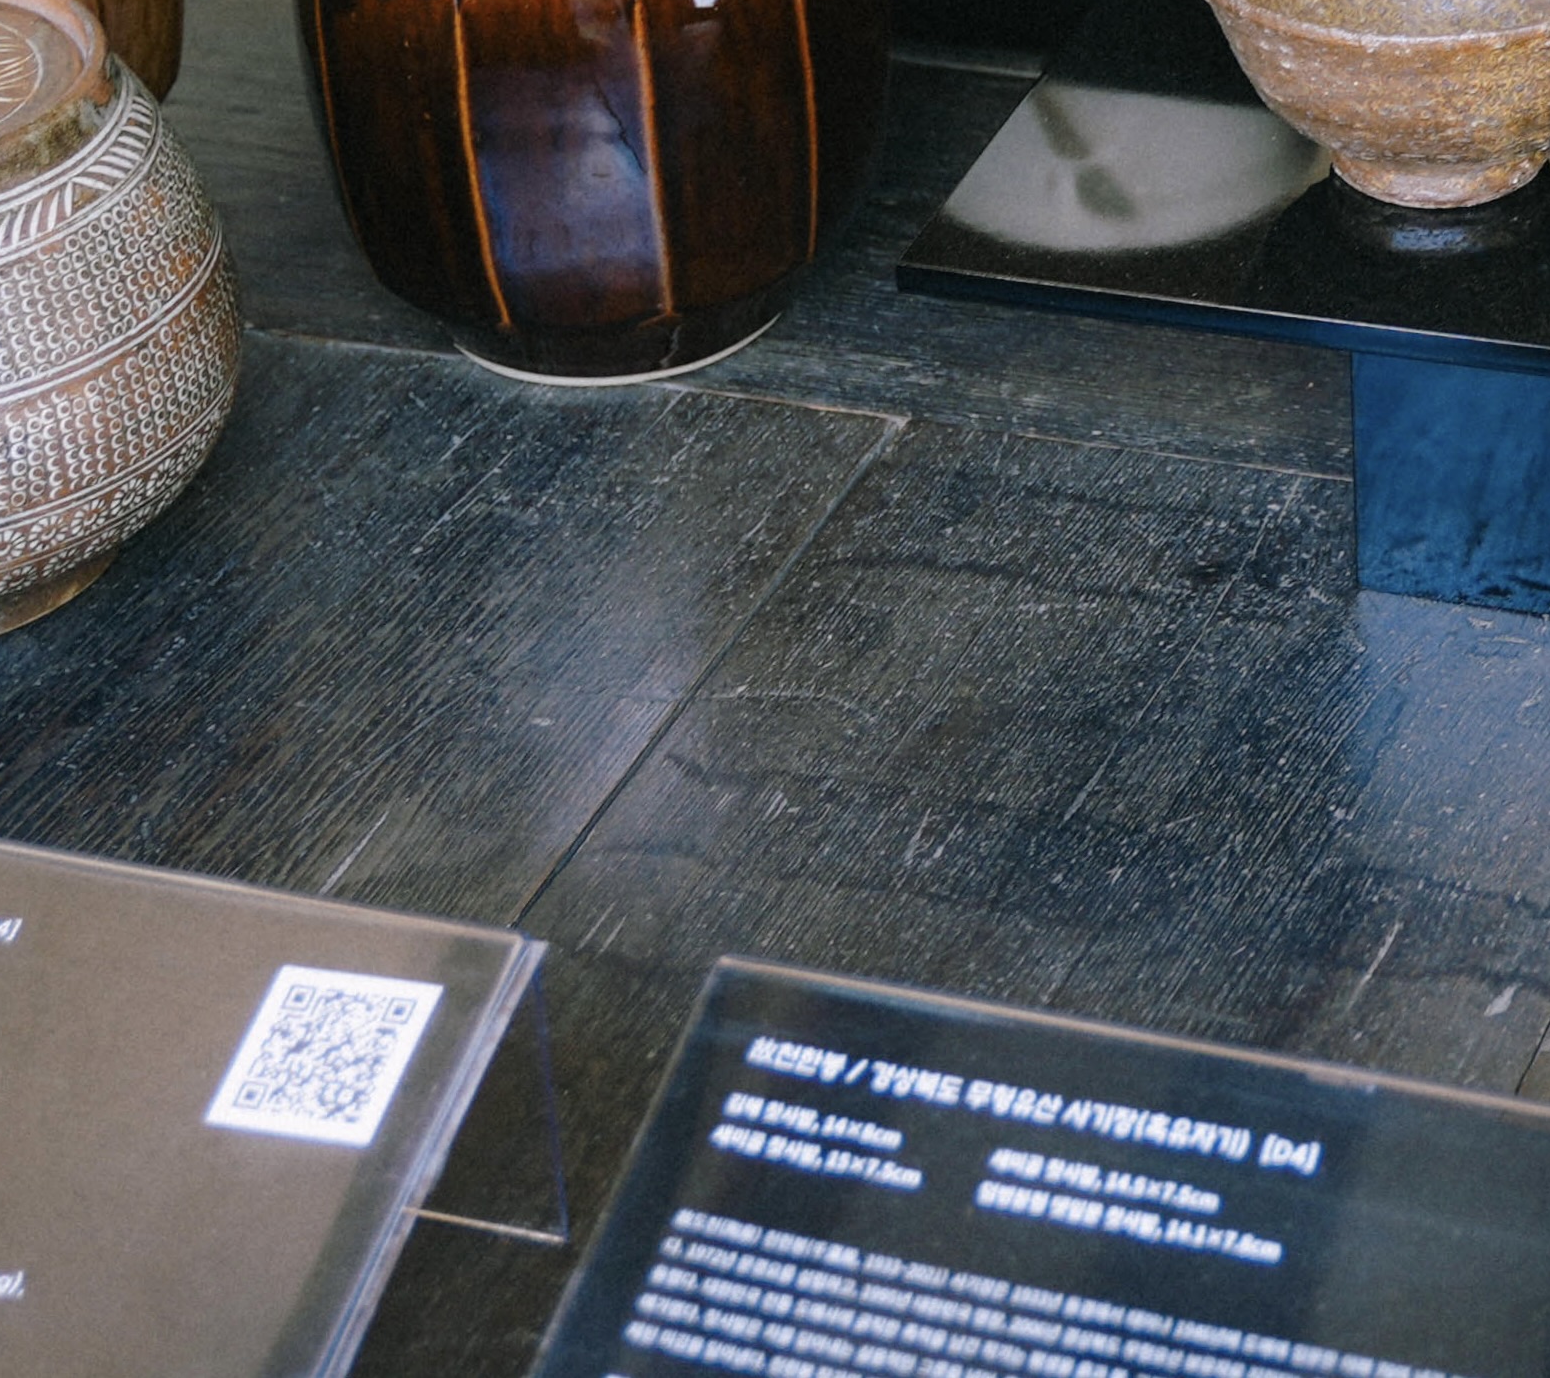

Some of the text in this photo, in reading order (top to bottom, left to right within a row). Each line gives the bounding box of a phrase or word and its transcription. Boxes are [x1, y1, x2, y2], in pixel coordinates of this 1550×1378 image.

[845, 1059, 868, 1082] /
[872, 1061, 963, 1103] 경상북도
[966, 1080, 1062, 1122] 무형유산
[1260, 1134, 1320, 1173] [D4]
